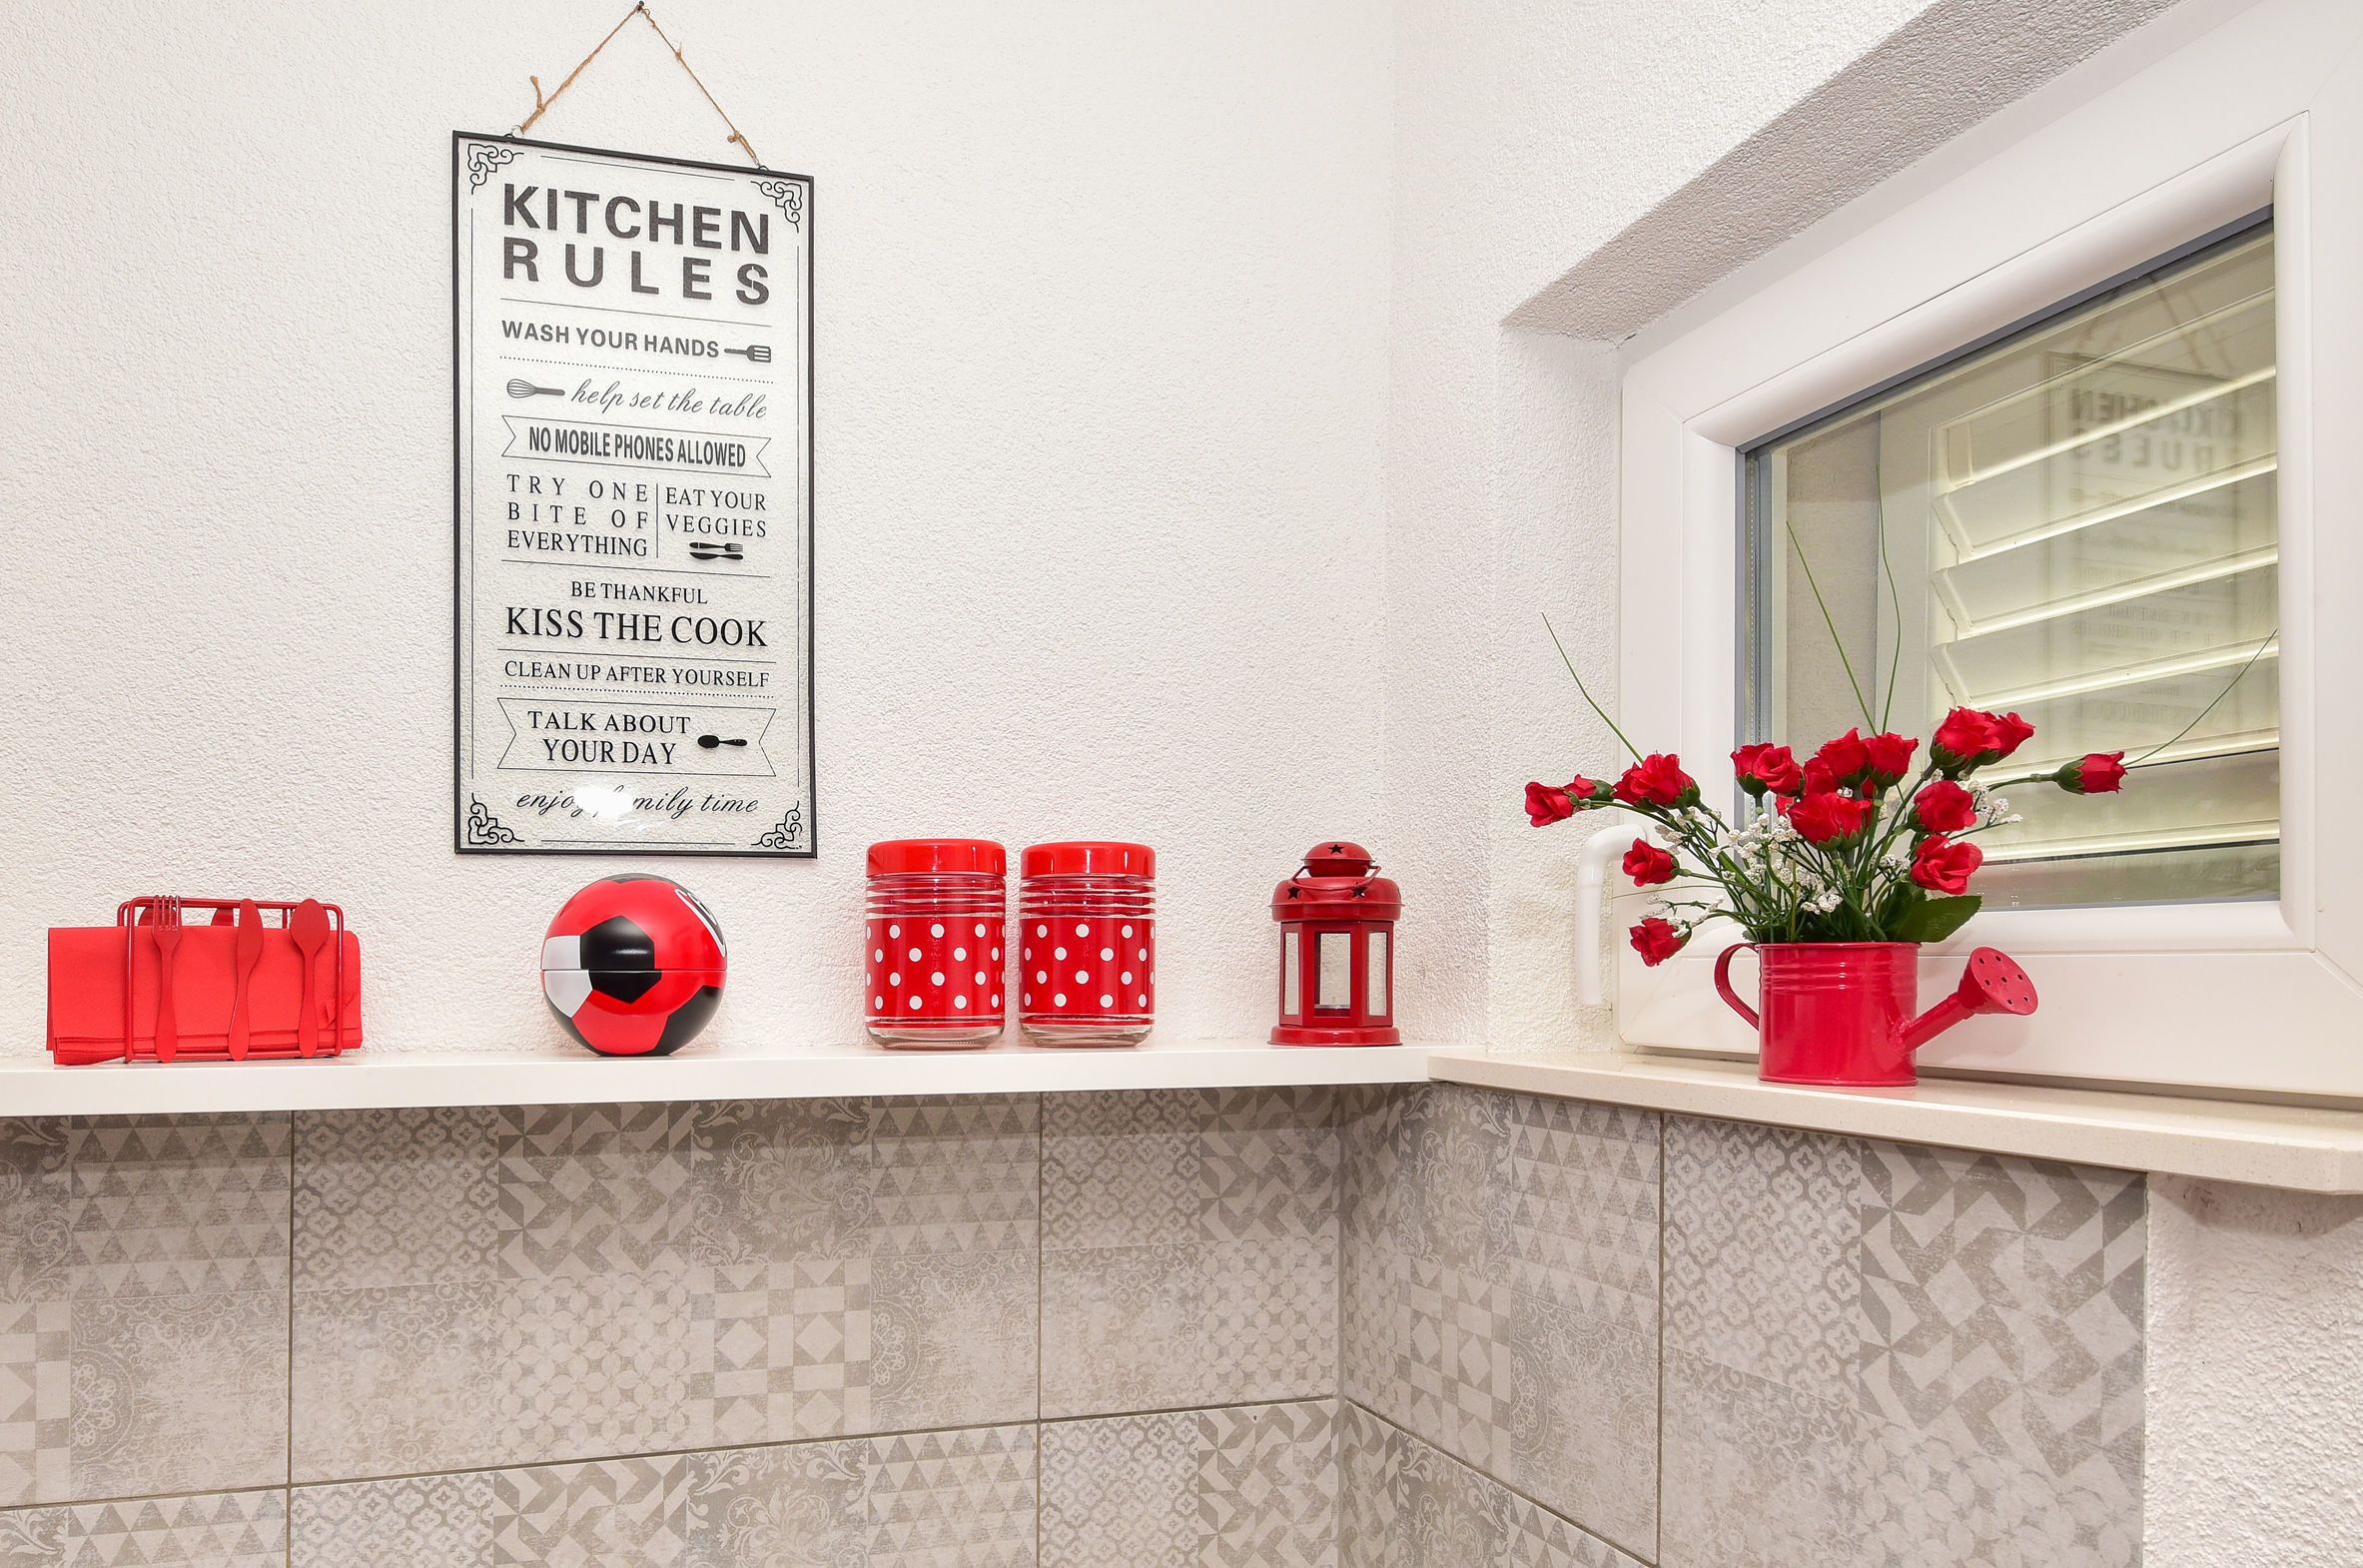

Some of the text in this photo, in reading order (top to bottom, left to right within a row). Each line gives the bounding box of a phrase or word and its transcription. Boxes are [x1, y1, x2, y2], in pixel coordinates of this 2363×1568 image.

[503, 183, 769, 256] KITCHEN
[503, 237, 770, 306] RULES
[501, 321, 720, 359] WASH YOUR HANDS
[571, 378, 767, 419] help set the table
[529, 426, 746, 468] NO MOBILE PHONES ALLOWED
[506, 473, 648, 502] TRY ONE
[665, 486, 767, 511] EAT YOUR
[507, 502, 649, 529] BITE OF
[665, 513, 766, 538] VEGGIES
[506, 529, 648, 557] EVERYTHING
[570, 580, 709, 605] BE THANKFUL
[504, 606, 769, 647] KISS THE COOK
[504, 660, 770, 688] CLEAN UP AFTER YOURSELF
[527, 710, 691, 735] TALK ABOUT
[542, 738, 677, 766] YOUR DAY
[592, 785, 694, 820] mily
[700, 793, 759, 812] time
